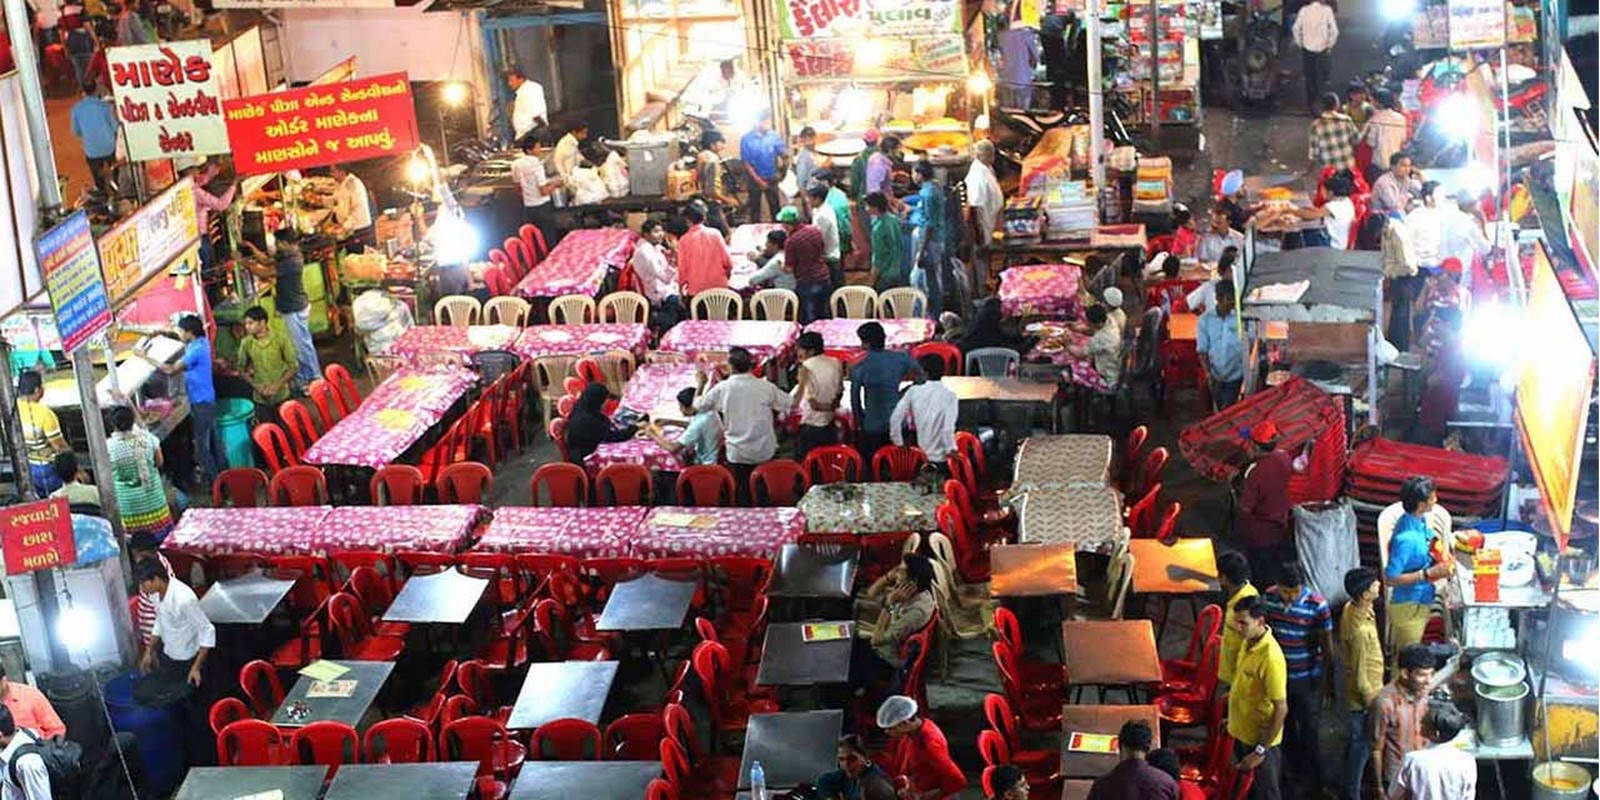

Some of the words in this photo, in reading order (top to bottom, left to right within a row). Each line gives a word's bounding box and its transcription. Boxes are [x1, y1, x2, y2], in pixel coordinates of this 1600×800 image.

[112, 47, 212, 89] માણેક
[228, 103, 265, 120] માણેક
[265, 116, 310, 138] ઓર્ડર
[315, 109, 379, 129] માણેકના
[255, 139, 319, 164] માણસોને
[325, 139, 340, 152] જ
[10, 503, 60, 528] રજવાડી
[23, 531, 54, 546] છાશ
[23, 548, 60, 569] મળશે
